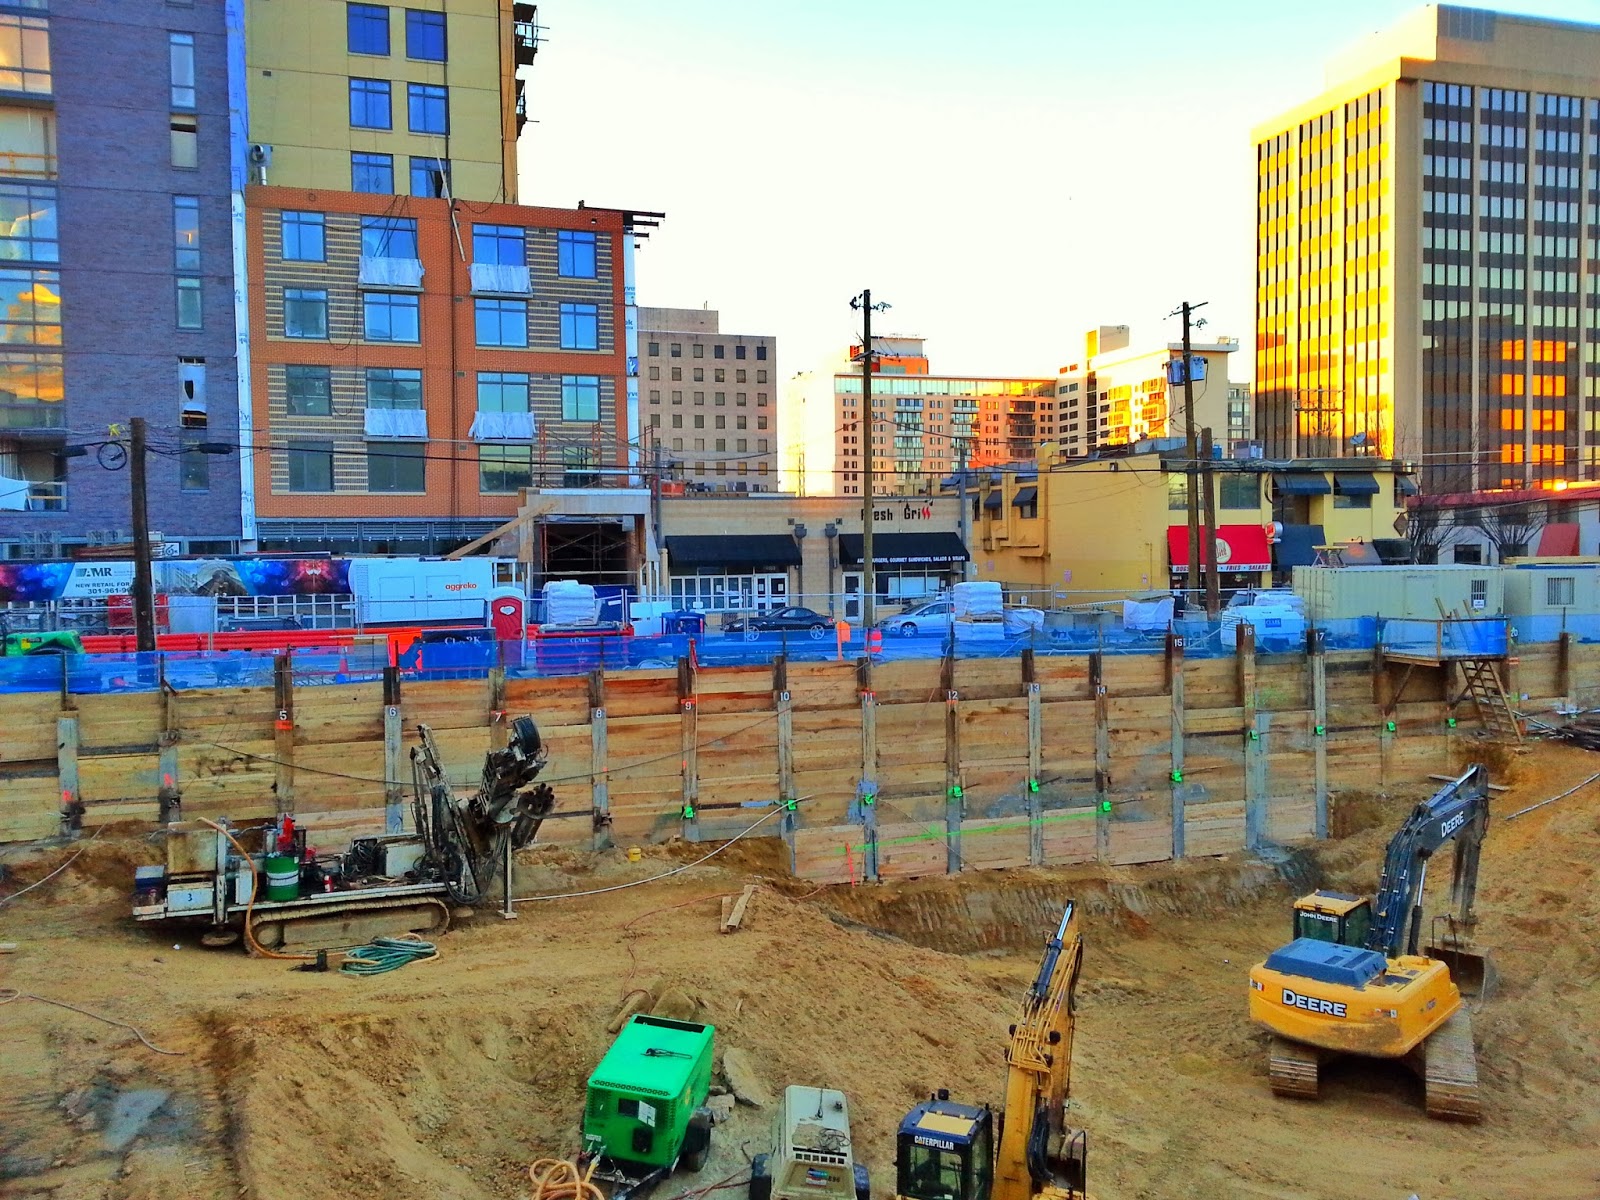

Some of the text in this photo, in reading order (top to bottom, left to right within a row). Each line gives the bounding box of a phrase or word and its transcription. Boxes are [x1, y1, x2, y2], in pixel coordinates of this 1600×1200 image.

[861, 508, 893, 521] Fesh
[445, 582, 477, 591] aggreko
[1315, 632, 1325, 641] 17
[1174, 637, 1183, 647] 15
[1029, 683, 1039, 692] 13
[1096, 685, 1106, 695] 14
[779, 691, 790, 701] 10
[864, 693, 873, 701] 11
[947, 690, 958, 700] 12
[684, 700, 692, 711] 9
[279, 710, 288, 720] 5
[389, 707, 397, 717] 6
[495, 711, 502, 722] 7
[596, 708, 603, 718] 8
[1441, 810, 1464, 838] DEERE
[1300, 910, 1338, 924] JOHN DEERE
[1281, 987, 1347, 1018] DEERE
[914, 1135, 955, 1151] CATERPILLAR
